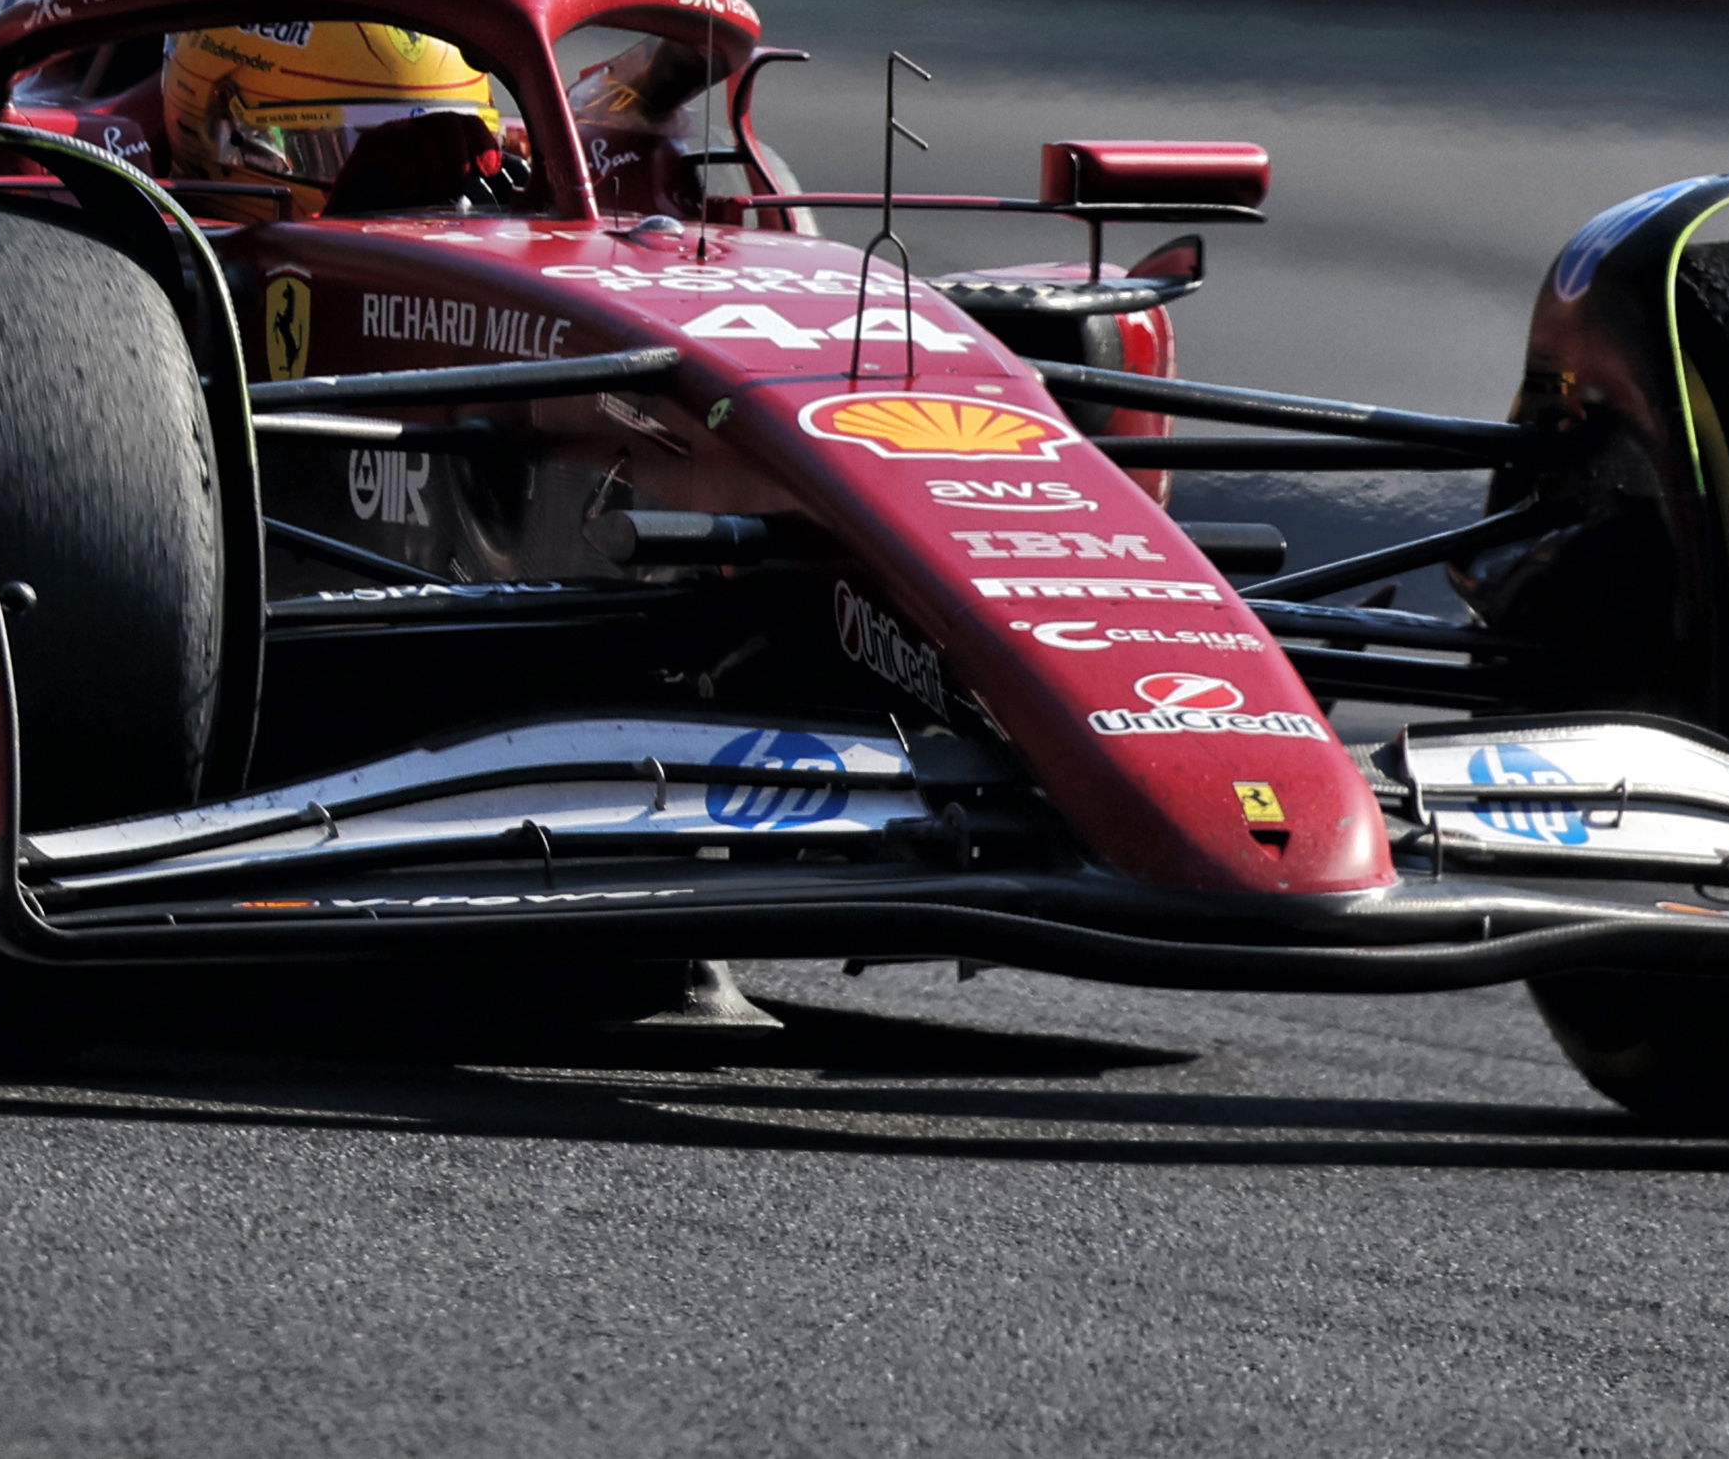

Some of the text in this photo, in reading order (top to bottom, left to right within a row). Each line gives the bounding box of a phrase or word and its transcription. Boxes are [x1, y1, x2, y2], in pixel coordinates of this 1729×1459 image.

[540, 264, 932, 289] GLOBAL
[598, 278, 922, 299] POKER
[362, 293, 573, 359] RICHARD MILLE
[680, 304, 977, 354] 44
[925, 479, 1084, 501] aws
[949, 530, 1167, 562] IBM
[970, 577, 1223, 602] PIRELLI
[1104, 628, 1262, 647] CELSIUS
[855, 594, 951, 724] UniCredit
[1089, 709, 1326, 741] UniCredit
